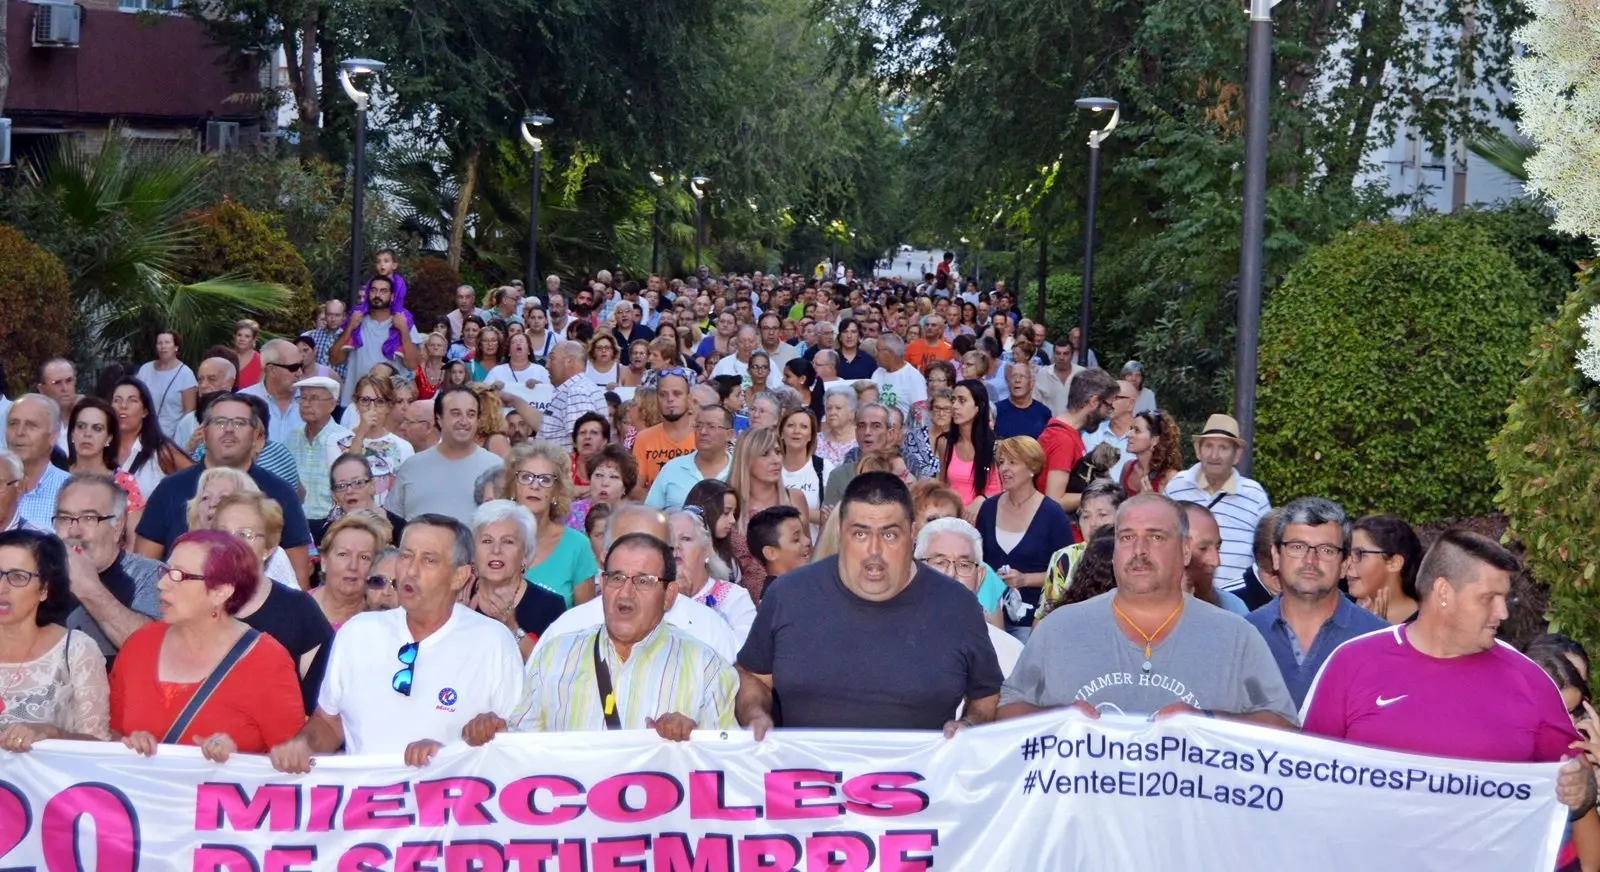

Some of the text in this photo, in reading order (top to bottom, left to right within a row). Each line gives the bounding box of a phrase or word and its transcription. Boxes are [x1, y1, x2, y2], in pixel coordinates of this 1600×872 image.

[1021, 733, 1531, 800] #PorUnasPlazasYsectoresPublicos
[1023, 769, 1283, 811] #VenteEl20aLas20
[195, 769, 930, 832] MIERCOLES
